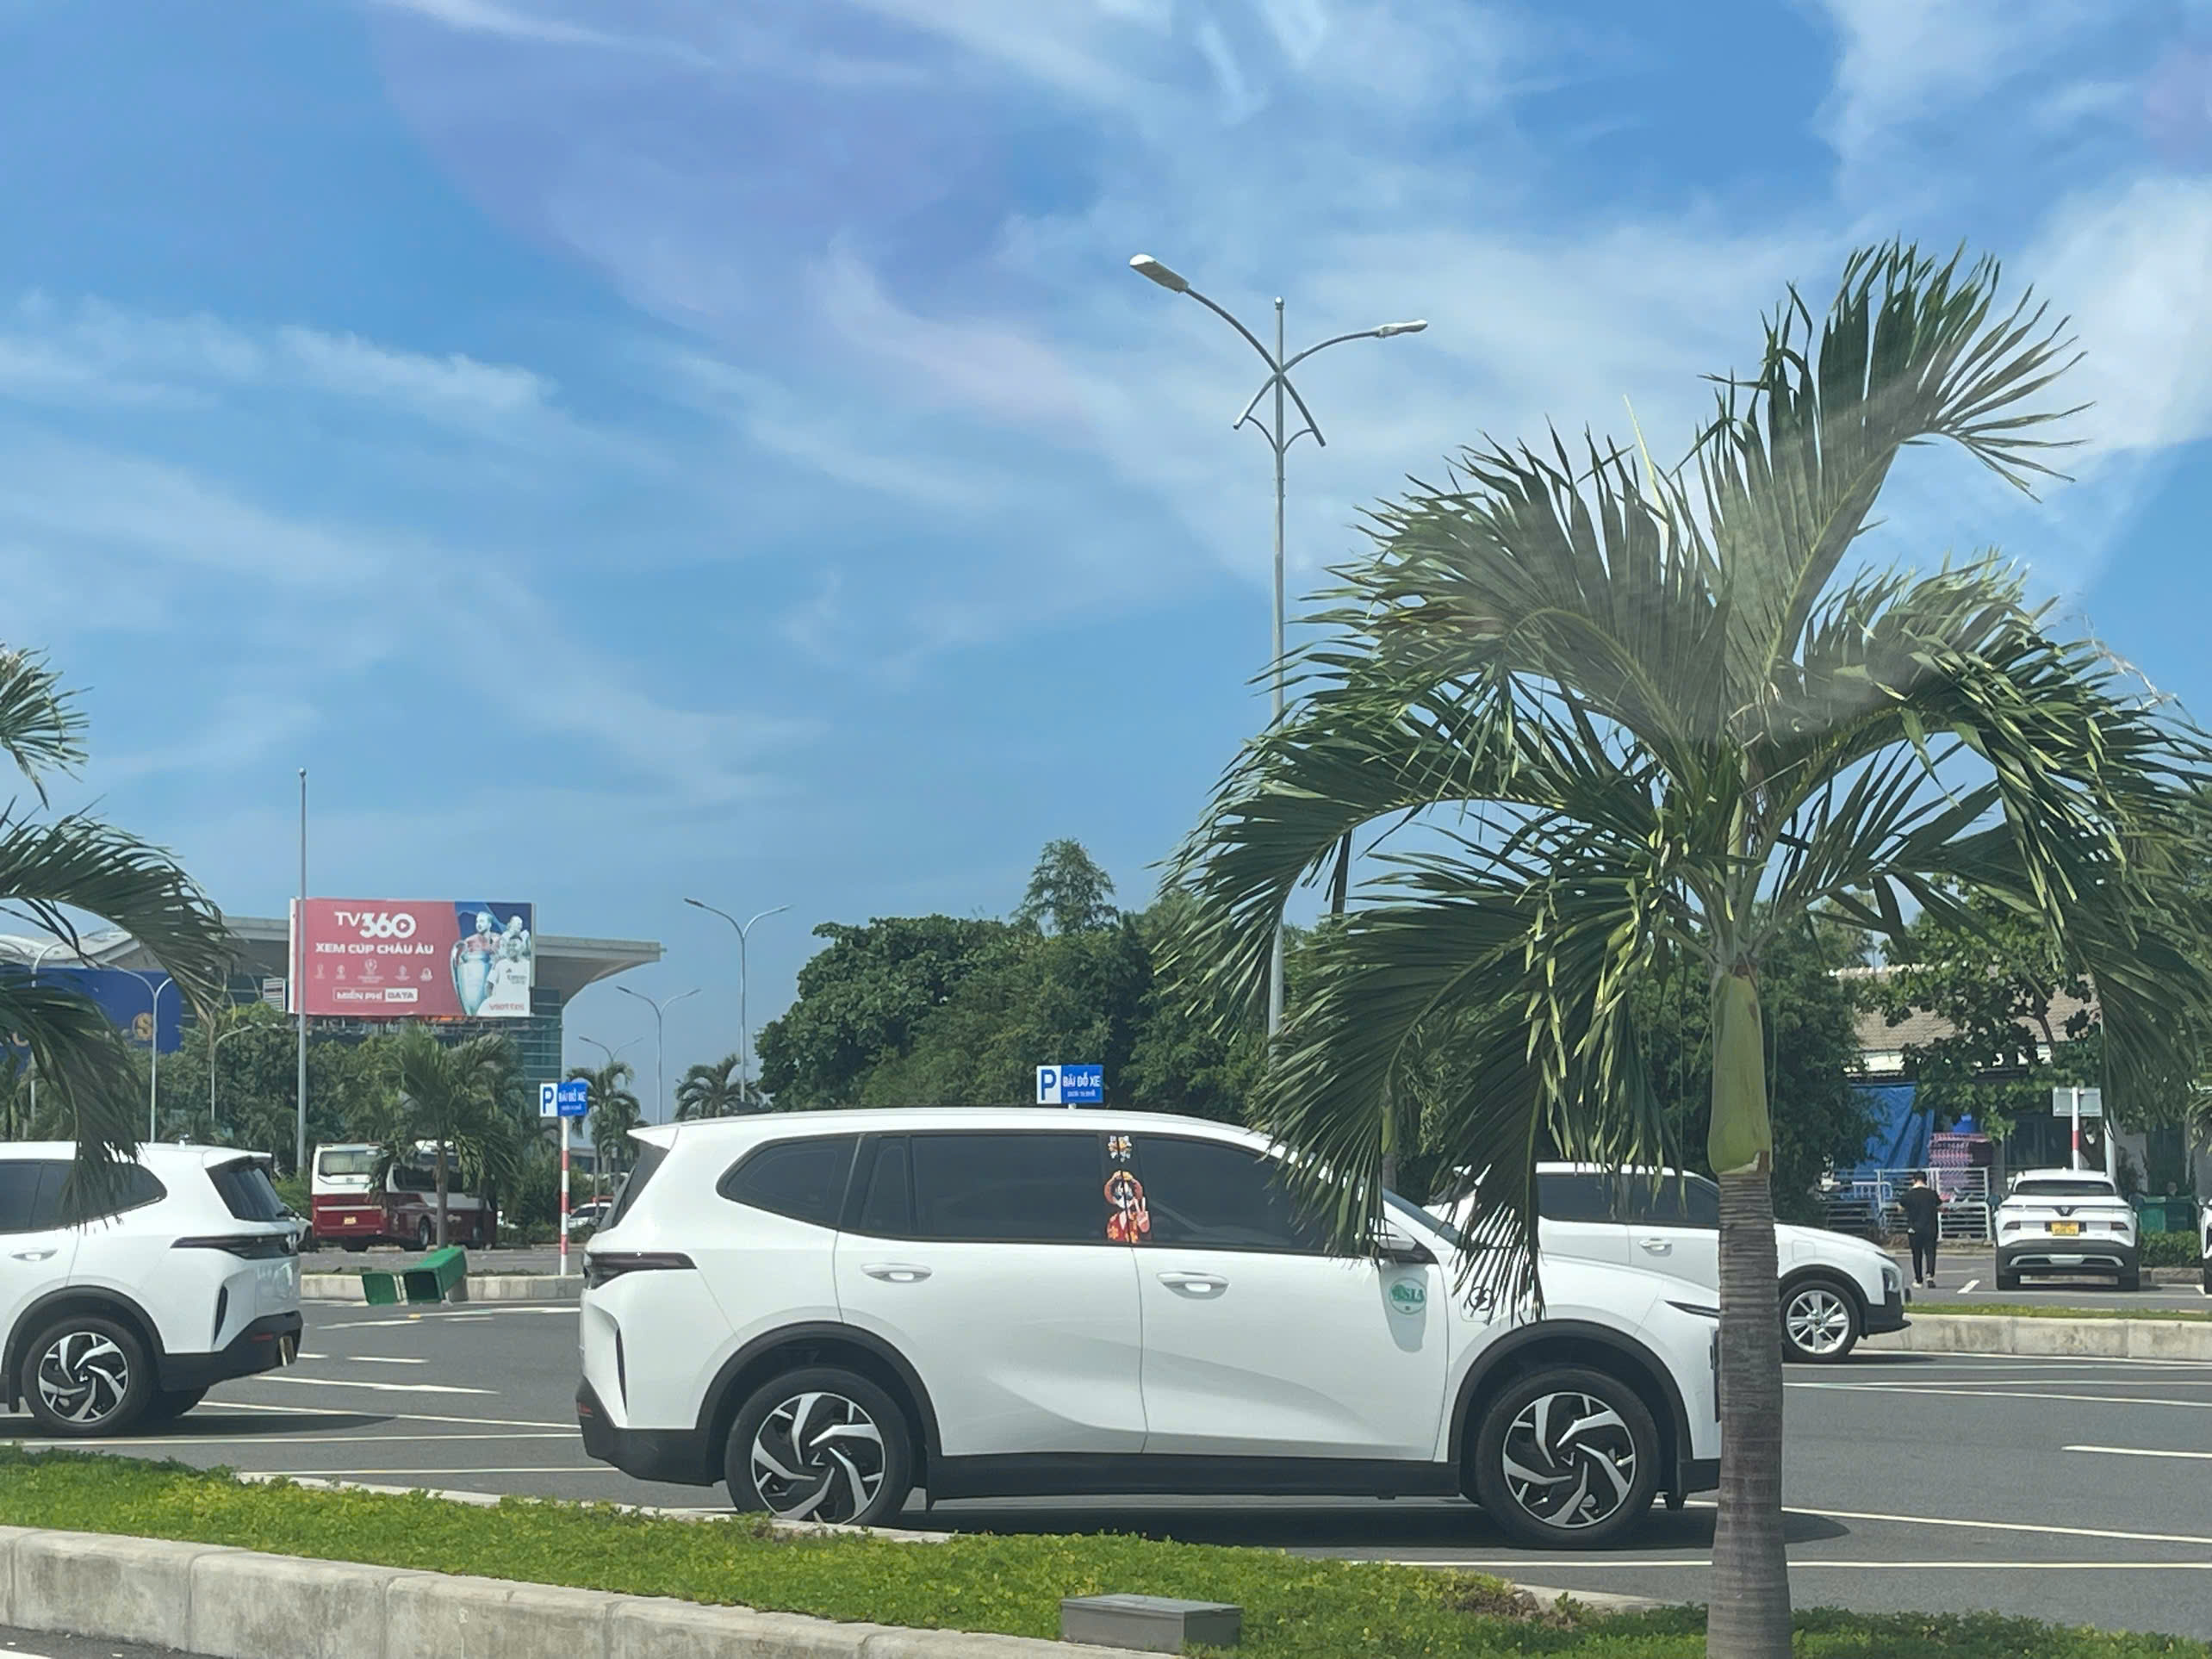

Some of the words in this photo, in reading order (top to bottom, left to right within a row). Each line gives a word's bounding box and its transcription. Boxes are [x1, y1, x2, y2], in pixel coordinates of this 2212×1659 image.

[315, 942, 345, 954] XEM
[387, 991, 414, 1000] DATA
[1041, 1069, 1057, 1101] P
[1090, 1075, 1101, 1087] XE
[543, 1086, 554, 1114] P
